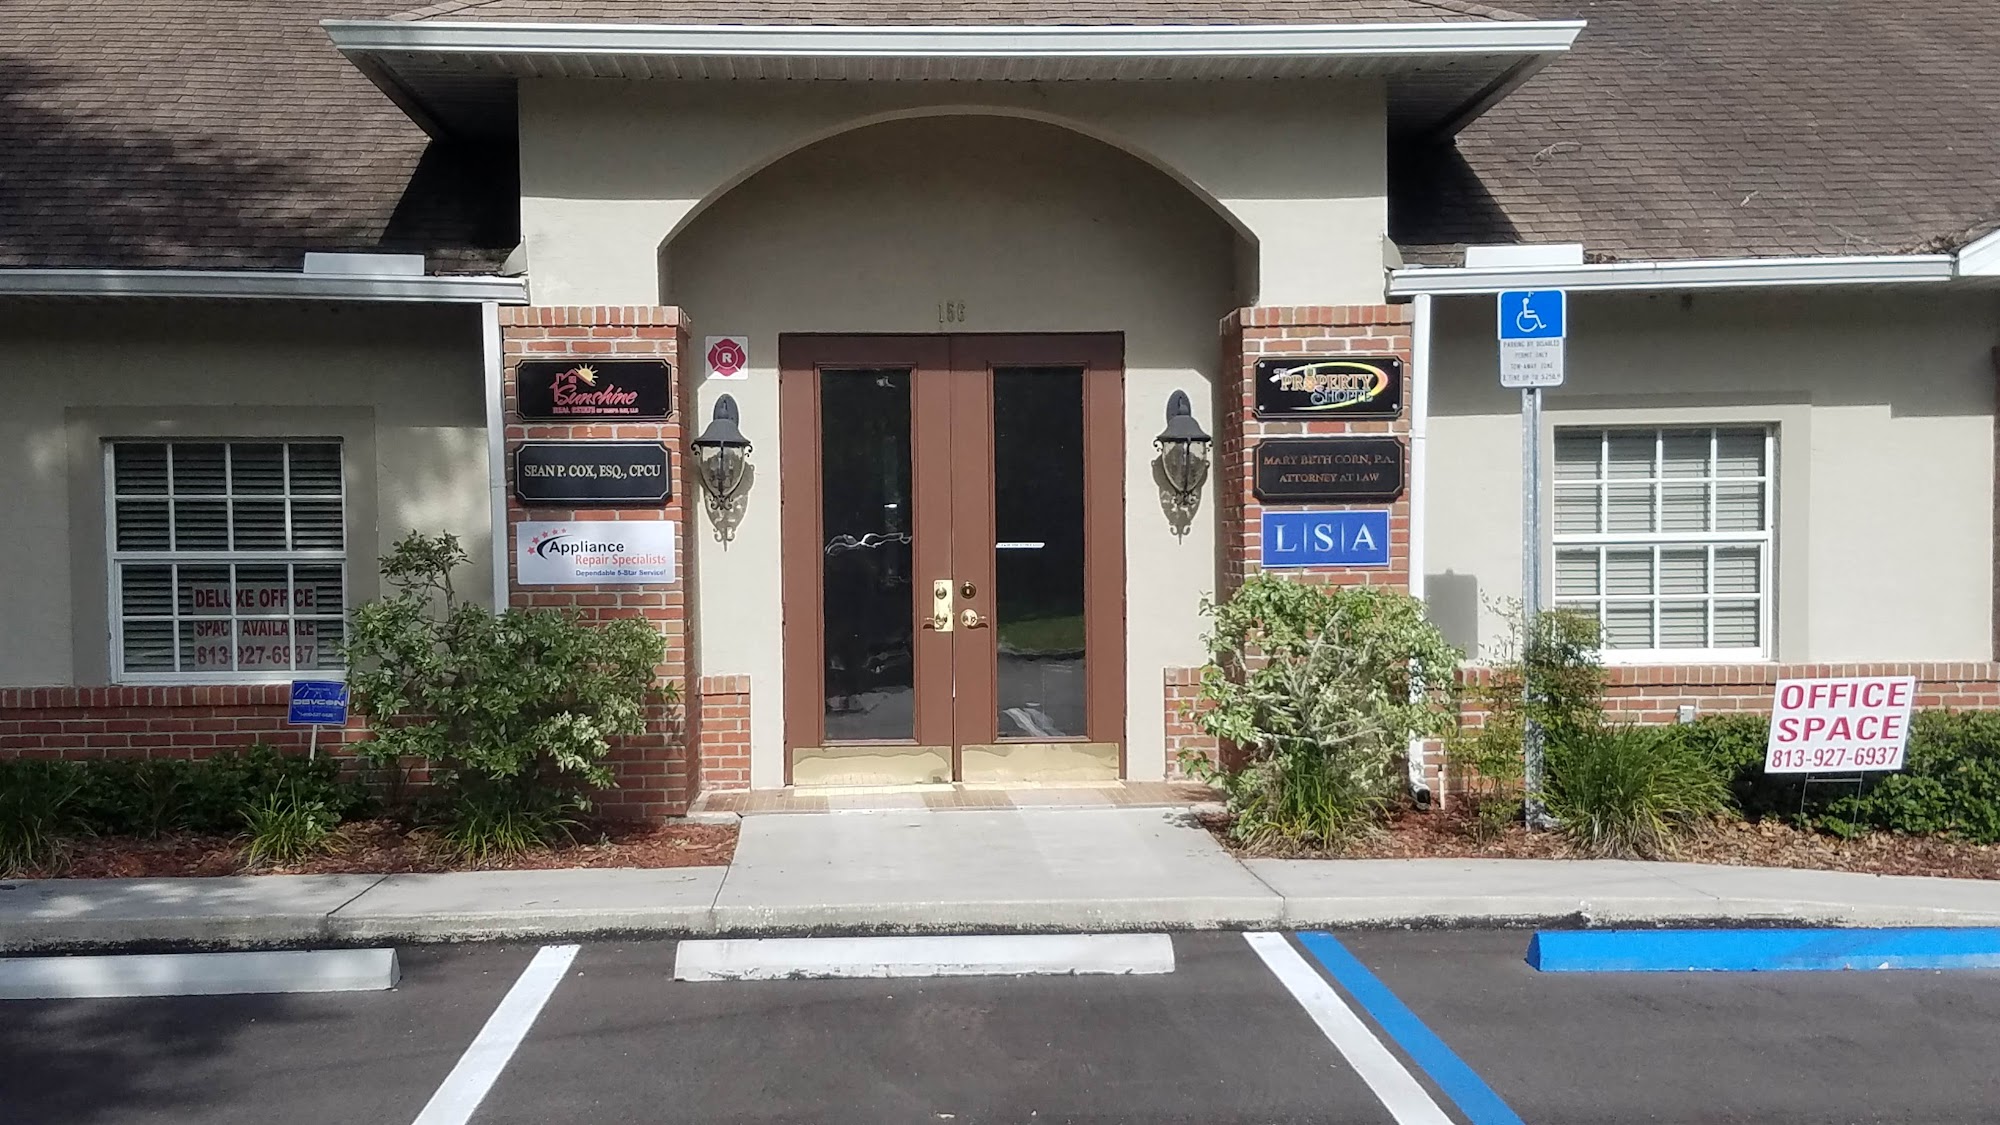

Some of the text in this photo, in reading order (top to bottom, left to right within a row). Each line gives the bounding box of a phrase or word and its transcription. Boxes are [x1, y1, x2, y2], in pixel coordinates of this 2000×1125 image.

[722, 352, 732, 363] R
[556, 383, 638, 405] Sunshine
[1310, 385, 1373, 405] SHOPPE
[1263, 456, 1299, 465] MARY
[1300, 455, 1332, 465] BETH
[1334, 455, 1372, 466] CORN,
[524, 465, 555, 477] SEAN
[557, 465, 566, 477] P.
[569, 465, 597, 479] COX,
[629, 465, 661, 477] CPCU
[1279, 473, 1380, 483] ATTORNEY AT LAW
[548, 541, 624, 556] Appliance
[575, 554, 666, 567] Repair Specialists
[576, 569, 615, 577] Dependable
[259, 588, 313, 608] OFFCE
[197, 620, 314, 636] SPAC AVAILALE
[1780, 683, 1908, 709] OFFICE
[1777, 715, 1902, 742] SPACE
[1772, 747, 1899, 768] 813-927-6937
